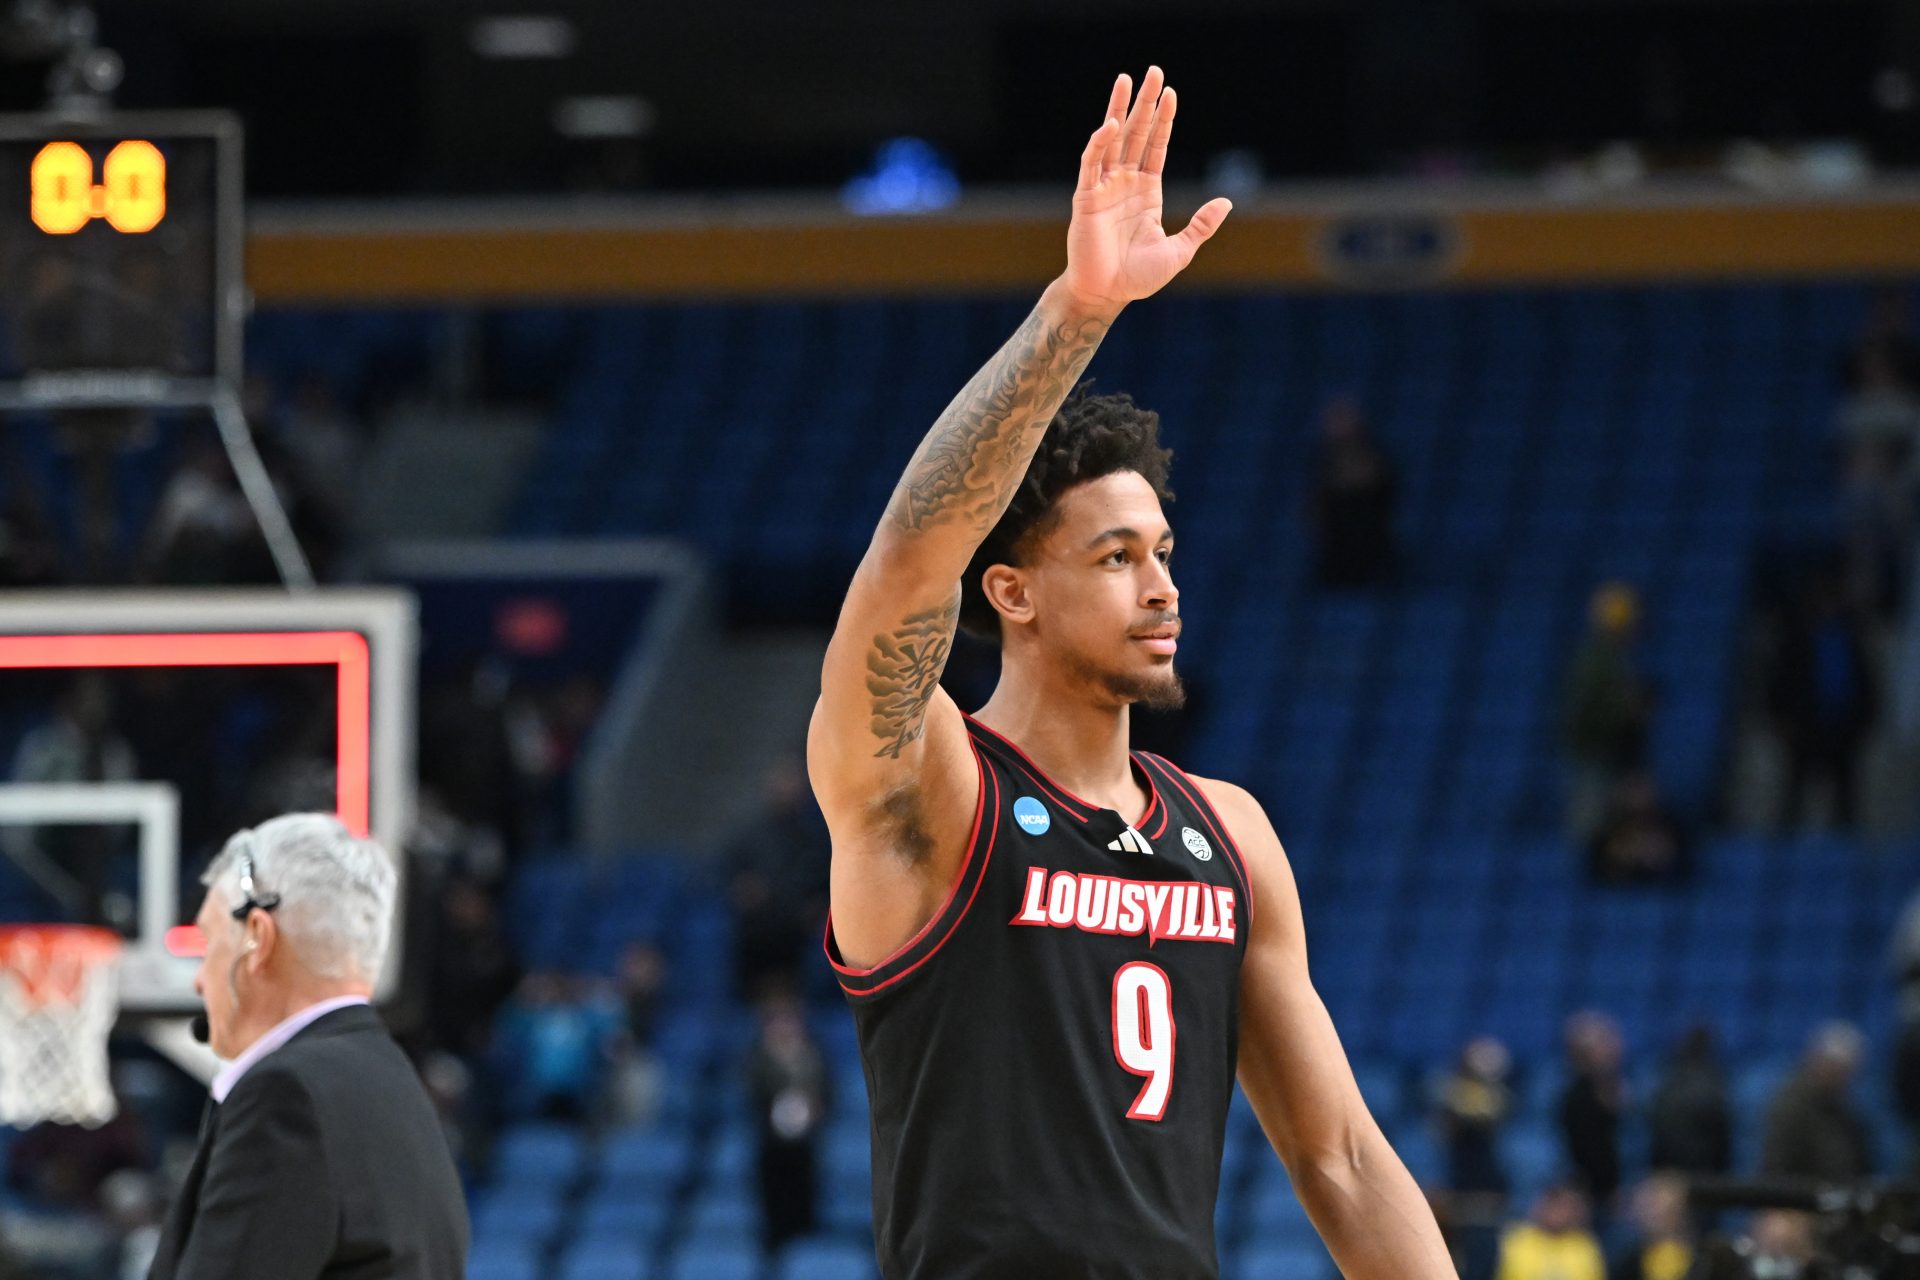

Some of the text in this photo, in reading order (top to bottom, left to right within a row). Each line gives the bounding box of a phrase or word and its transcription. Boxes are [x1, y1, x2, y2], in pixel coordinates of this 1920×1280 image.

[1020, 814, 1049, 825] NCAA
[1009, 866, 1236, 948] LOUISVILLE
[1113, 961, 1176, 1121] 9
